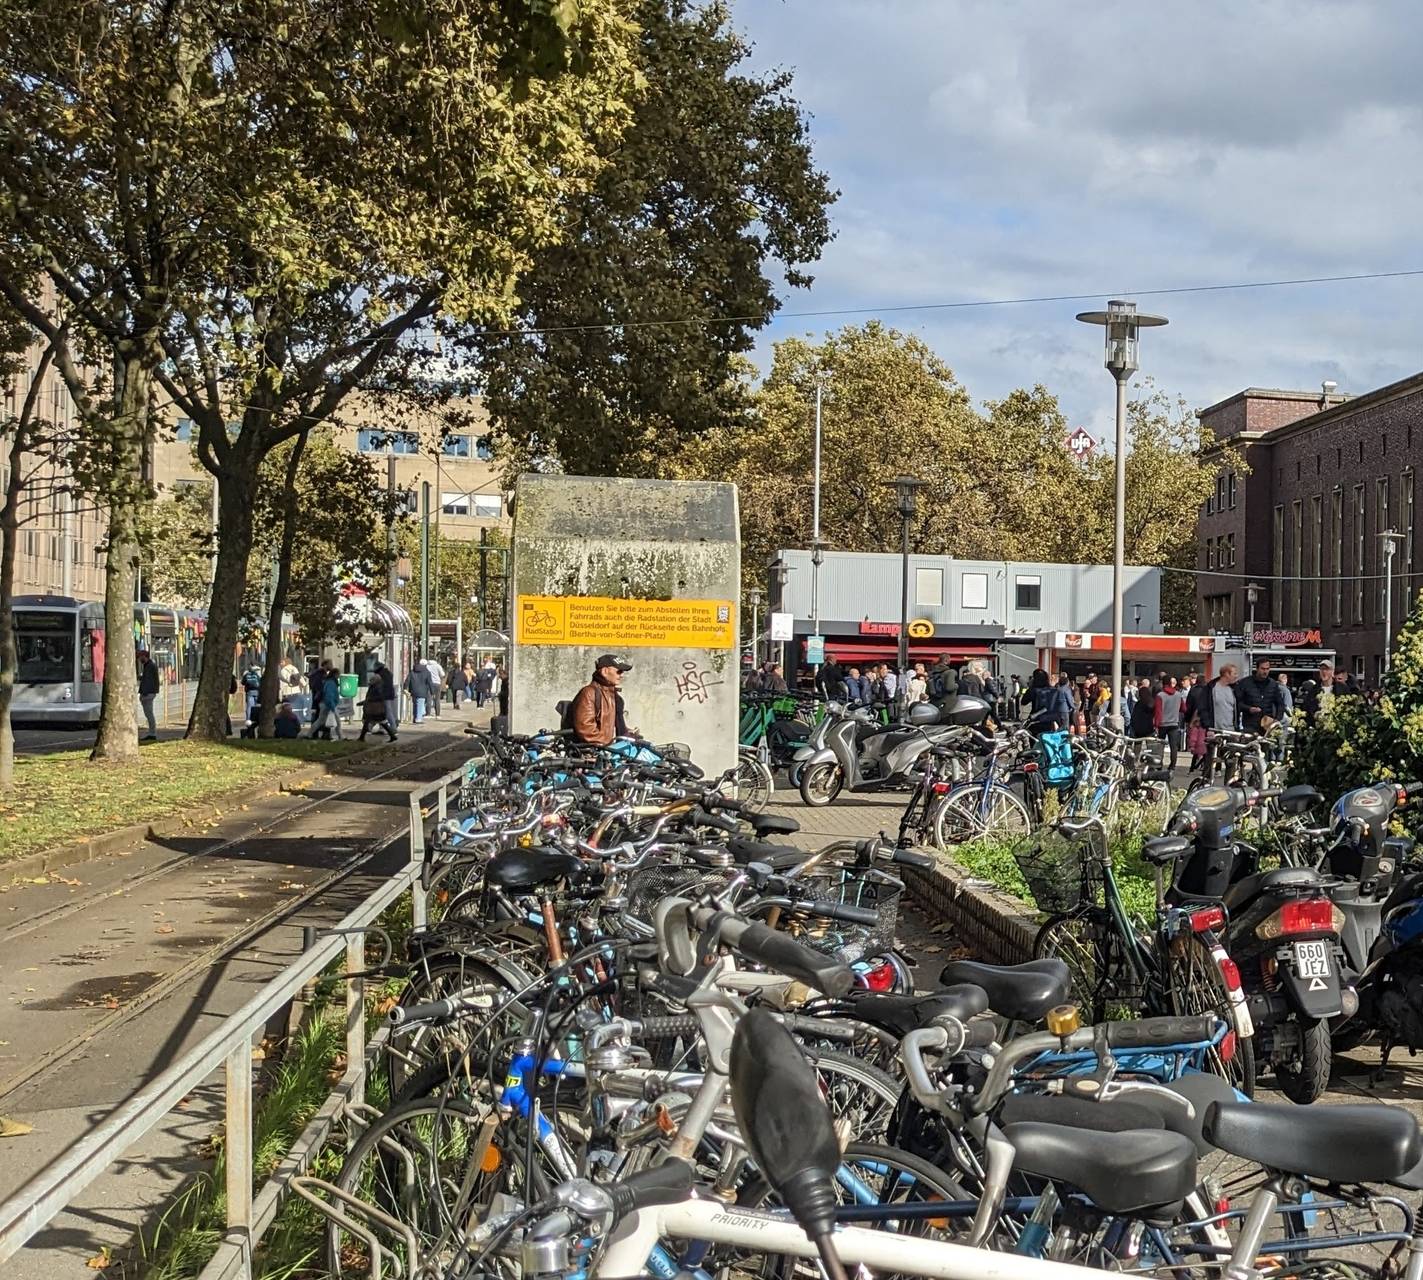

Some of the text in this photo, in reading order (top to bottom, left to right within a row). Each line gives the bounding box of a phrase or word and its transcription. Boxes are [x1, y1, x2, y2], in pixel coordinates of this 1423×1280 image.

[569, 603, 605, 612] Benutzen
[606, 604, 618, 612] Sie
[619, 604, 636, 613] bitte
[655, 606, 690, 614] Abstellen
[692, 607, 709, 615] Ihres
[569, 612, 712, 624] Fahrrads auch die Radstation der Stadt
[569, 621, 610, 630] Düsseldorf
[612, 622, 623, 630] auf
[639, 623, 675, 632] Rückseite
[676, 624, 690, 632] des
[692, 624, 728, 633] Bahnhofs.
[861, 621, 901, 637] Kamp
[569, 630, 666, 640] (Bertha-von-Suttner-Platz)
[1298, 944, 1323, 960] 660
[1304, 960, 1327, 975] JEZ
